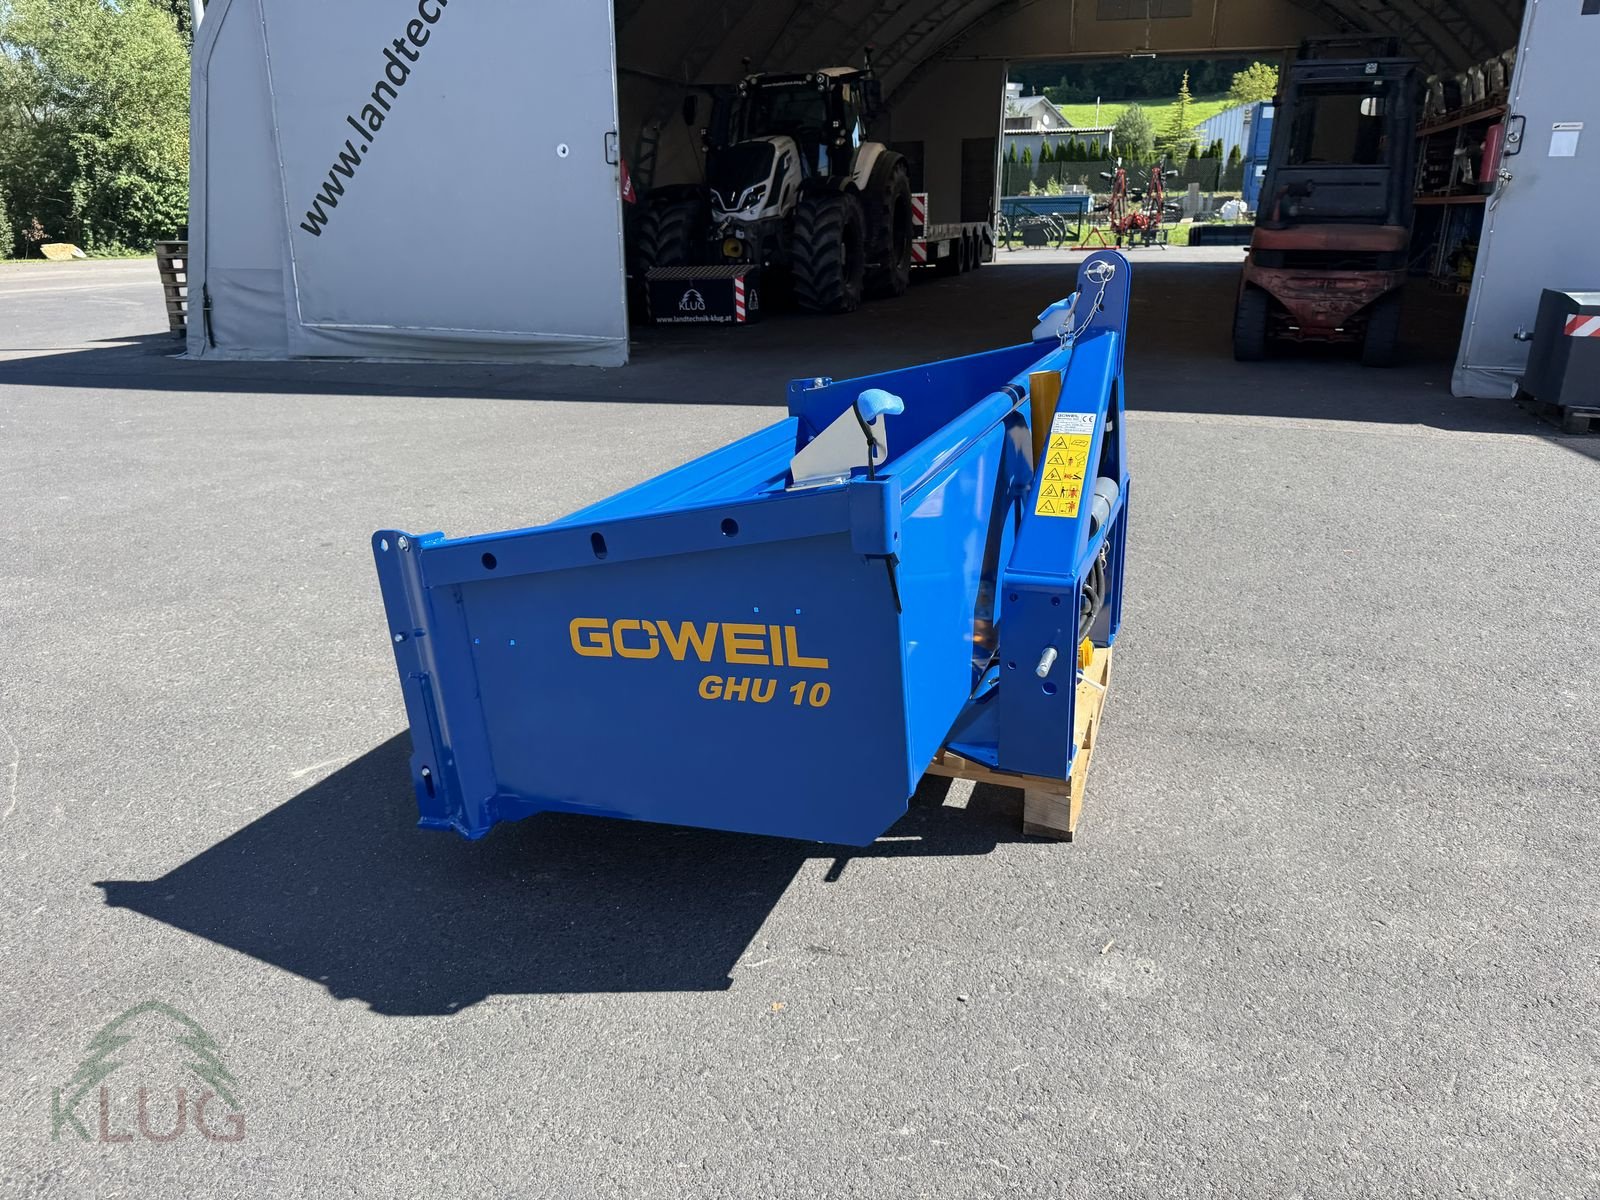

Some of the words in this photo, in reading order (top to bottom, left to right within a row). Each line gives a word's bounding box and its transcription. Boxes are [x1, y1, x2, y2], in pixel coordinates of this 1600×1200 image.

[300, 0, 447, 237] www.landtec
[679, 301, 706, 311] KLUG
[656, 314, 732, 323] www.landtechnik-klug.at
[698, 675, 777, 703] GHU
[789, 681, 831, 707] 10
